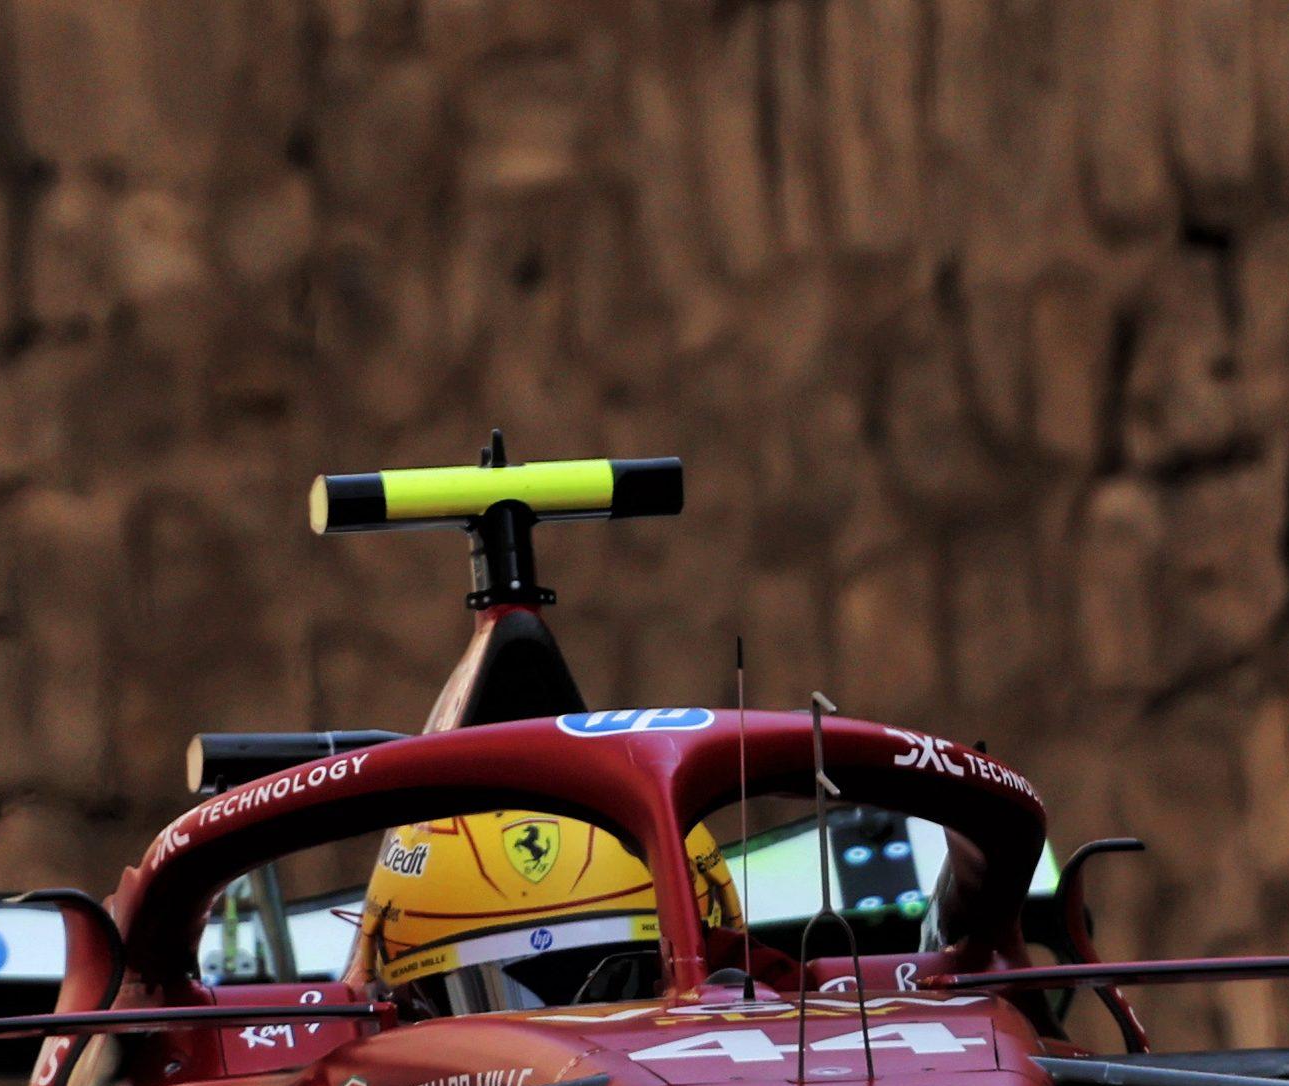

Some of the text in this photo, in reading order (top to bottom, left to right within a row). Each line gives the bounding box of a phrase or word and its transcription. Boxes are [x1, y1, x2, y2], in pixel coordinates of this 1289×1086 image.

[199, 753, 370, 826] TECHNOLOGY
[531, 928, 553, 950] hp
[628, 1021, 986, 1063] 44
